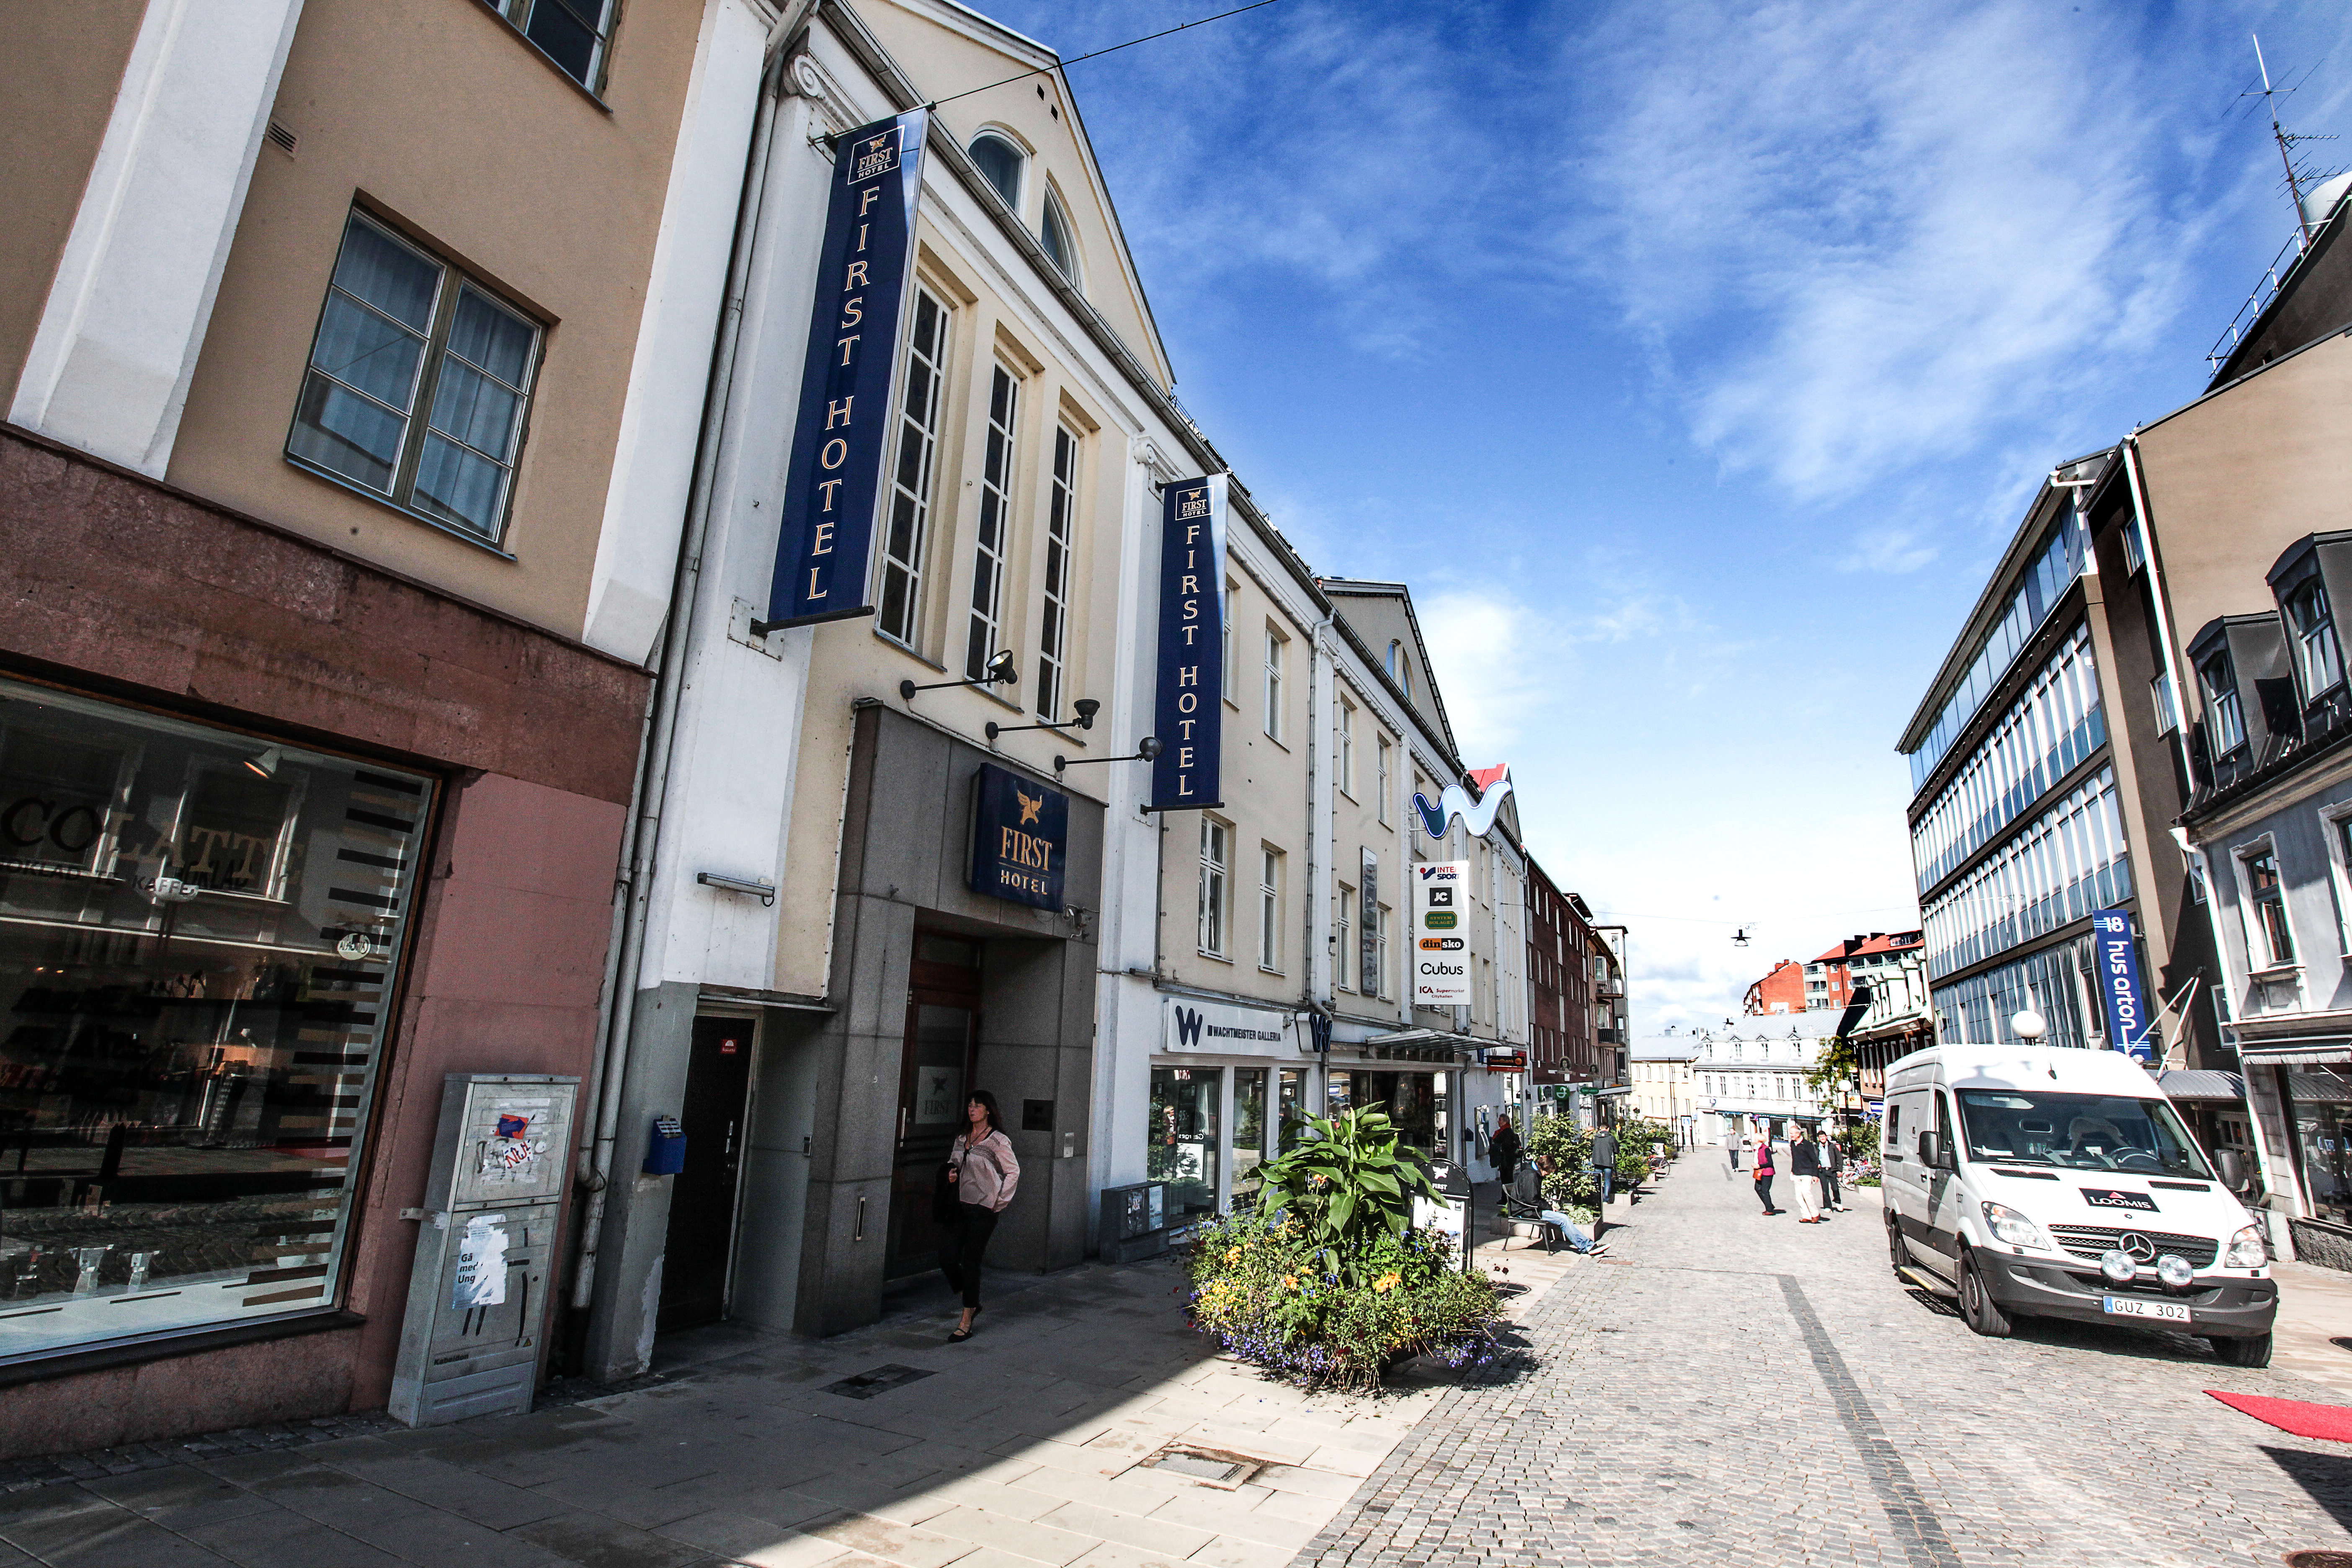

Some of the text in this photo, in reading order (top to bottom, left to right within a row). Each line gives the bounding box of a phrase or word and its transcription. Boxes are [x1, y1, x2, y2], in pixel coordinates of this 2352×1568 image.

[859, 147, 893, 170] FIRST
[858, 162, 889, 178] HOTEL
[807, 186, 879, 600] FIRST HOTEL
[1182, 499, 1207, 513] FIRST
[1179, 525, 1200, 795] FIRST HOTEL
[1000, 826, 1052, 871] FIRST
[1001, 869, 1047, 895] HOTEL
[1434, 892, 1448, 902] JC
[1423, 939, 1461, 949] dinsko
[1420, 962, 1463, 975] Cubus
[2103, 916, 2137, 1054] 18 hus arton
[1213, 1026, 1256, 1040] WACHTMEISTER
[1258, 1030, 1281, 1042] GALLERIA
[2089, 1196, 2152, 1209] LOOMIS
[461, 1253, 473, 1262] Gå
[2115, 1300, 2184, 1318] GUZ 302
